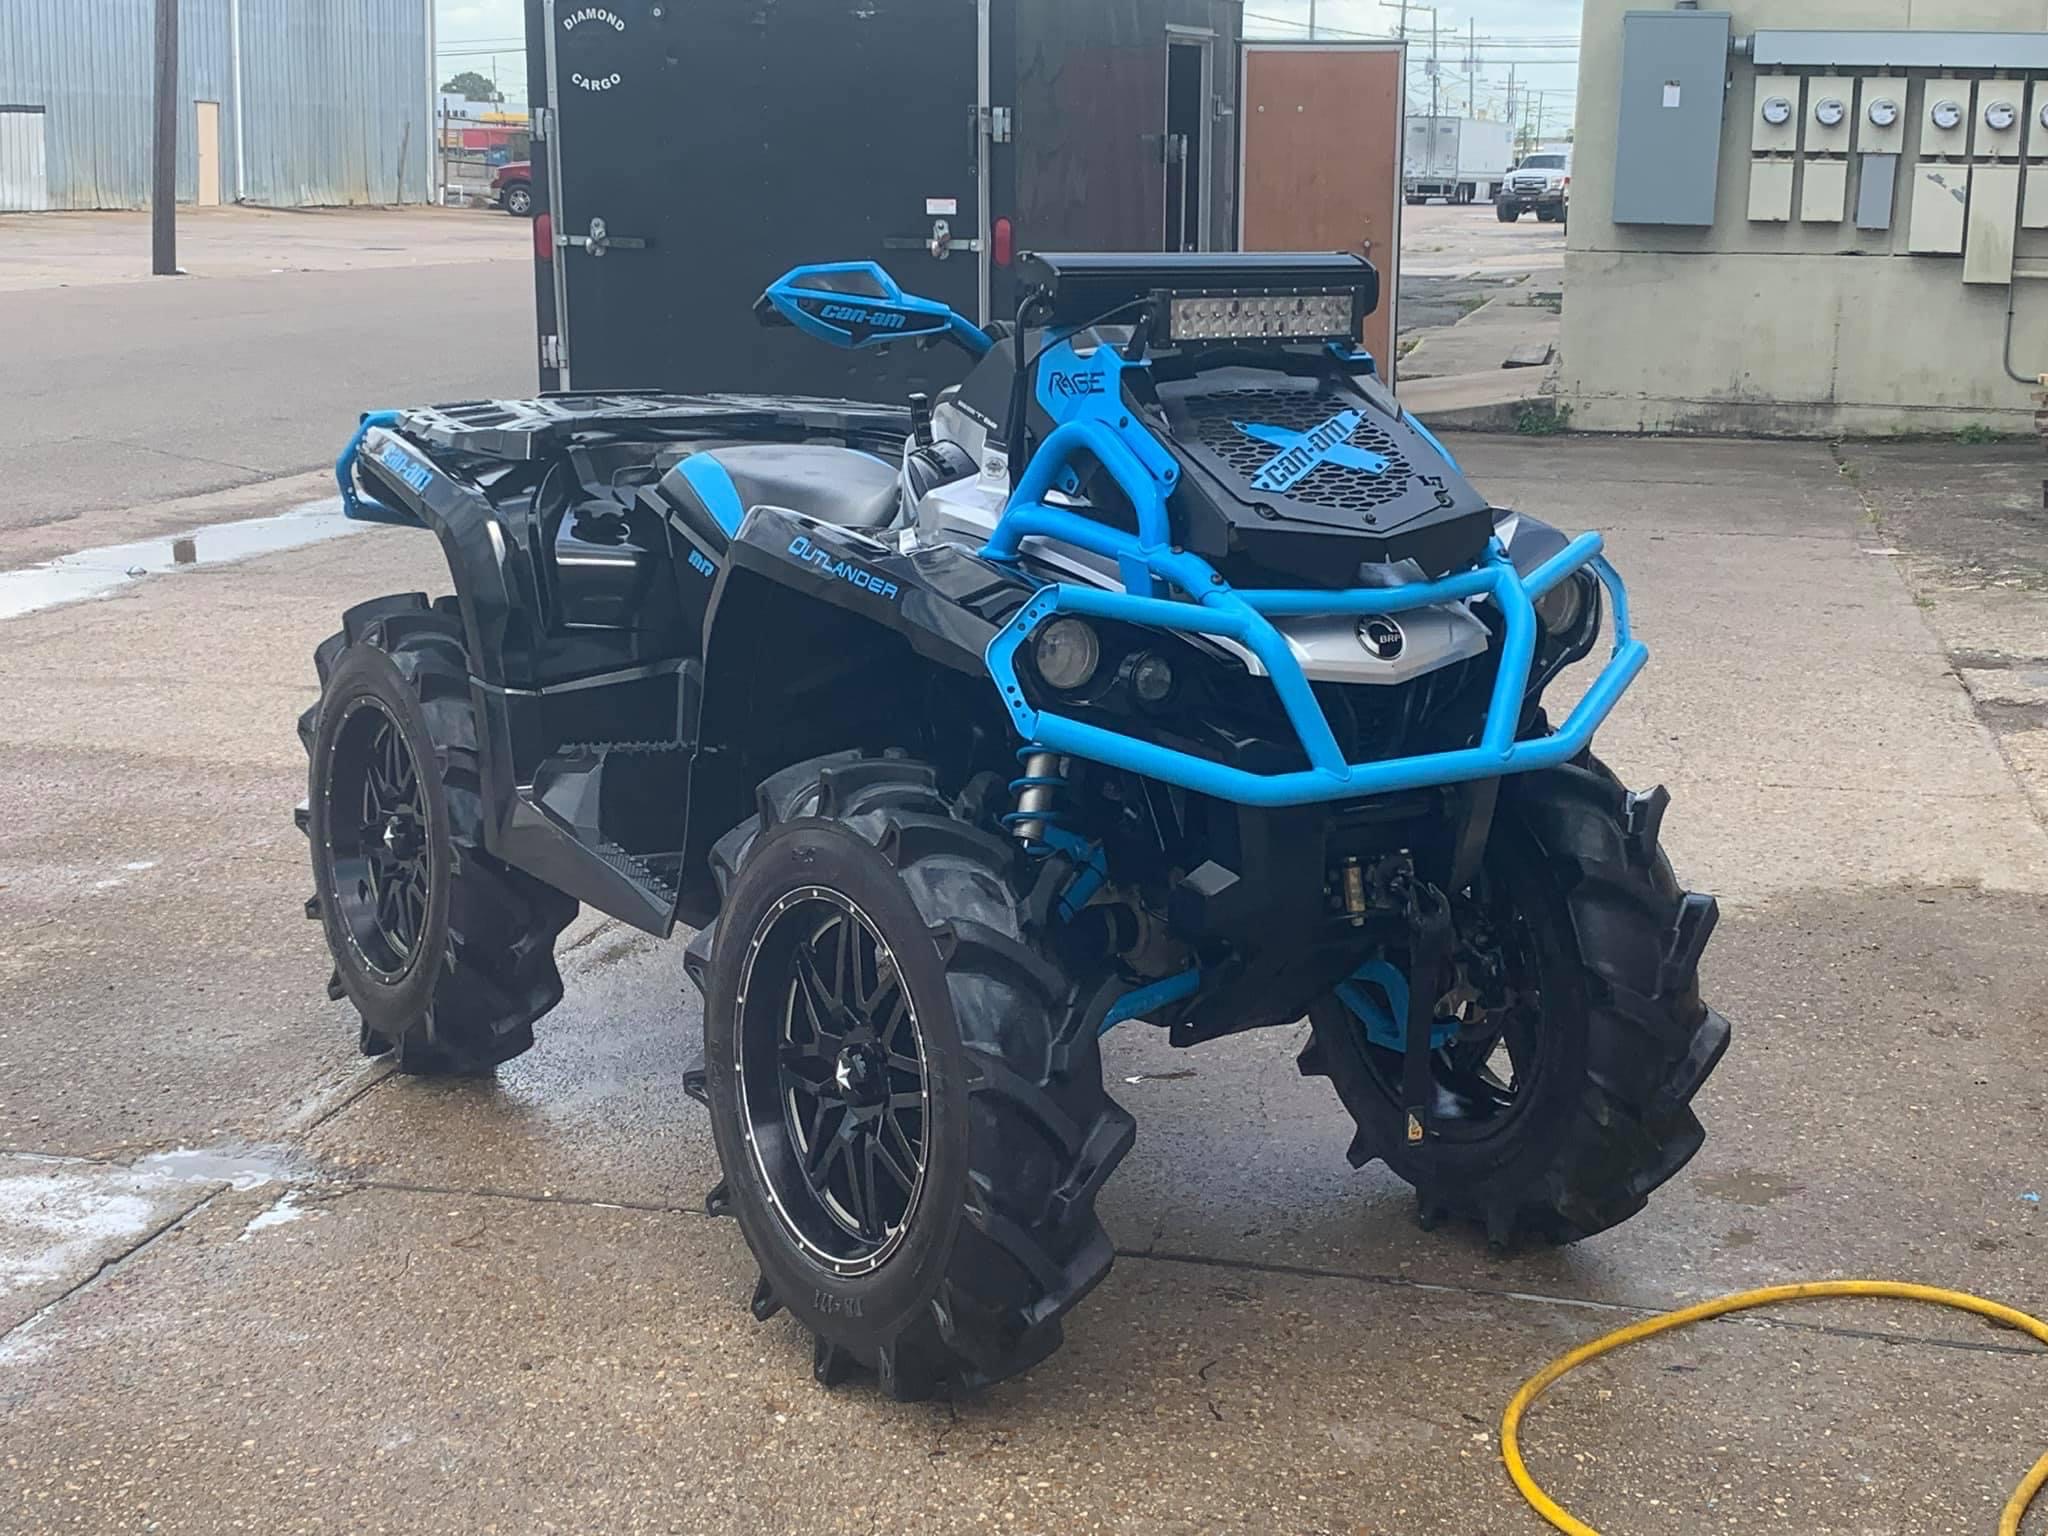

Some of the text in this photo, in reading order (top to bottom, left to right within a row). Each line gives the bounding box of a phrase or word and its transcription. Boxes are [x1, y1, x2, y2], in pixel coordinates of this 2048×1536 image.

[563, 8, 625, 31] DIAMOND
[571, 73, 621, 91] CARGO
[1048, 372, 1105, 400] RAGE
[1379, 634, 1401, 644] BRP
